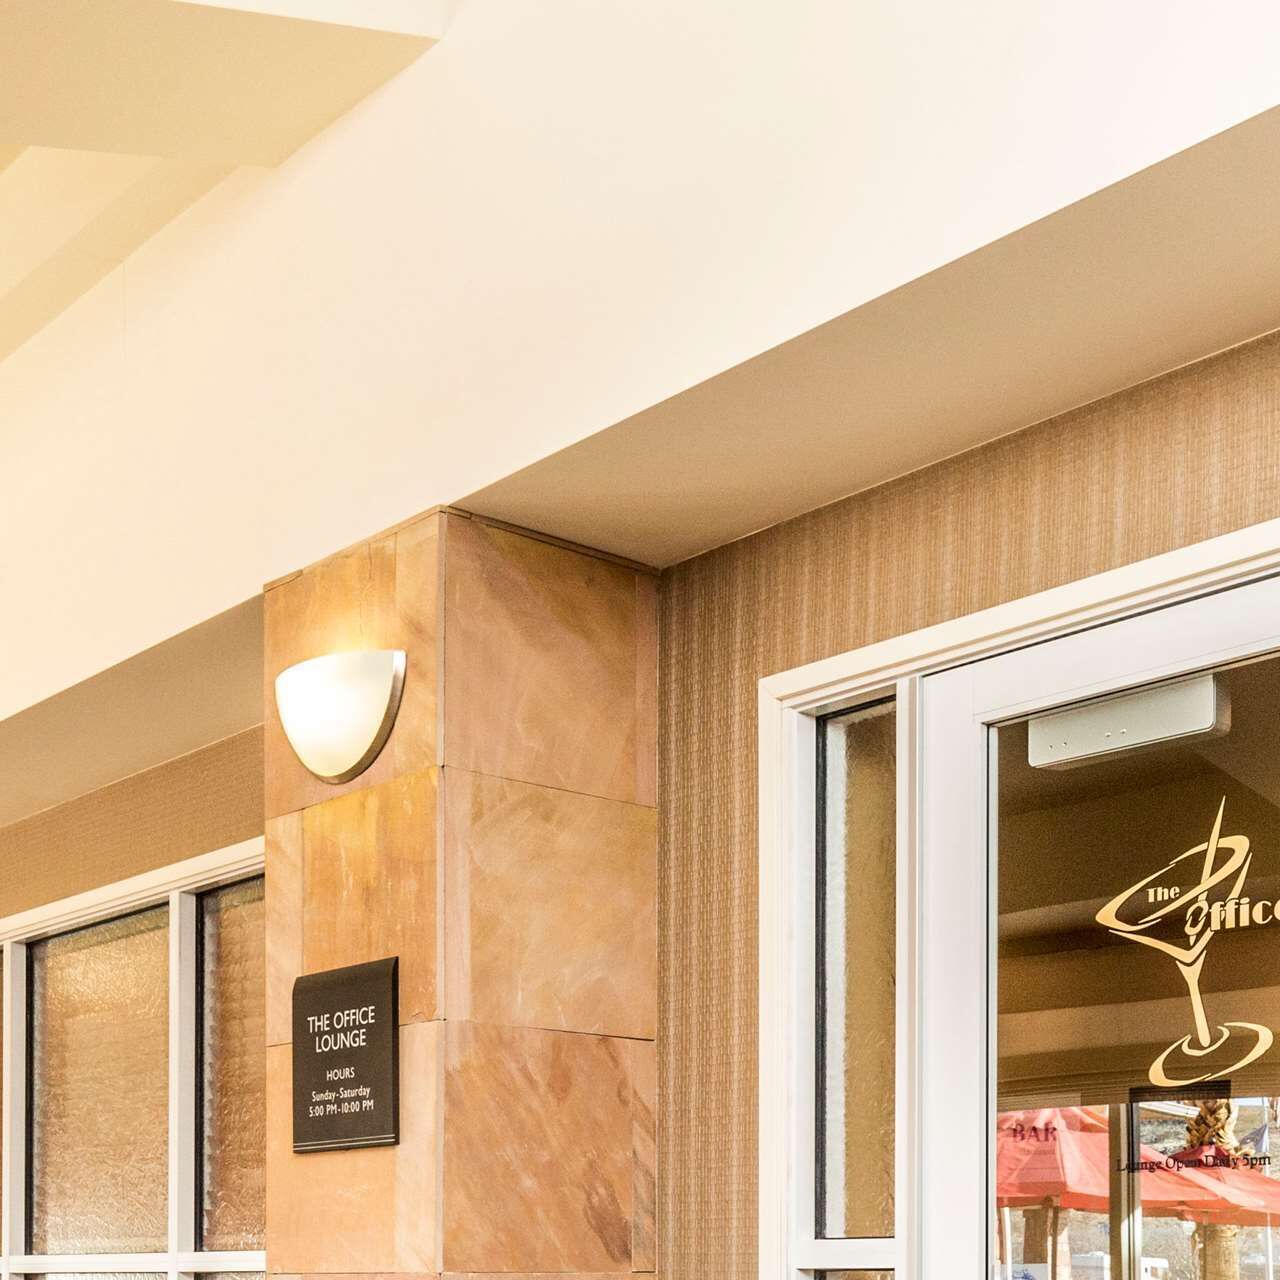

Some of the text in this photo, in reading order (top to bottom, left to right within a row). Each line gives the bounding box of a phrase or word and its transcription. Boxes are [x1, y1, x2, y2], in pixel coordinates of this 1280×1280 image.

[1146, 886, 1181, 903] The
[307, 1006, 376, 1034] THE OFFICE
[315, 1029, 367, 1053] LOUNGE
[326, 1067, 356, 1081] HOURS
[308, 1105, 324, 1118] 5:00
[362, 1099, 374, 1112] PM
[1012, 1121, 1057, 1142] BAR
[1116, 1159, 1163, 1174] Lounge
[1165, 1156, 1201, 1172] Open
[1242, 1153, 1272, 1169] 5pm
